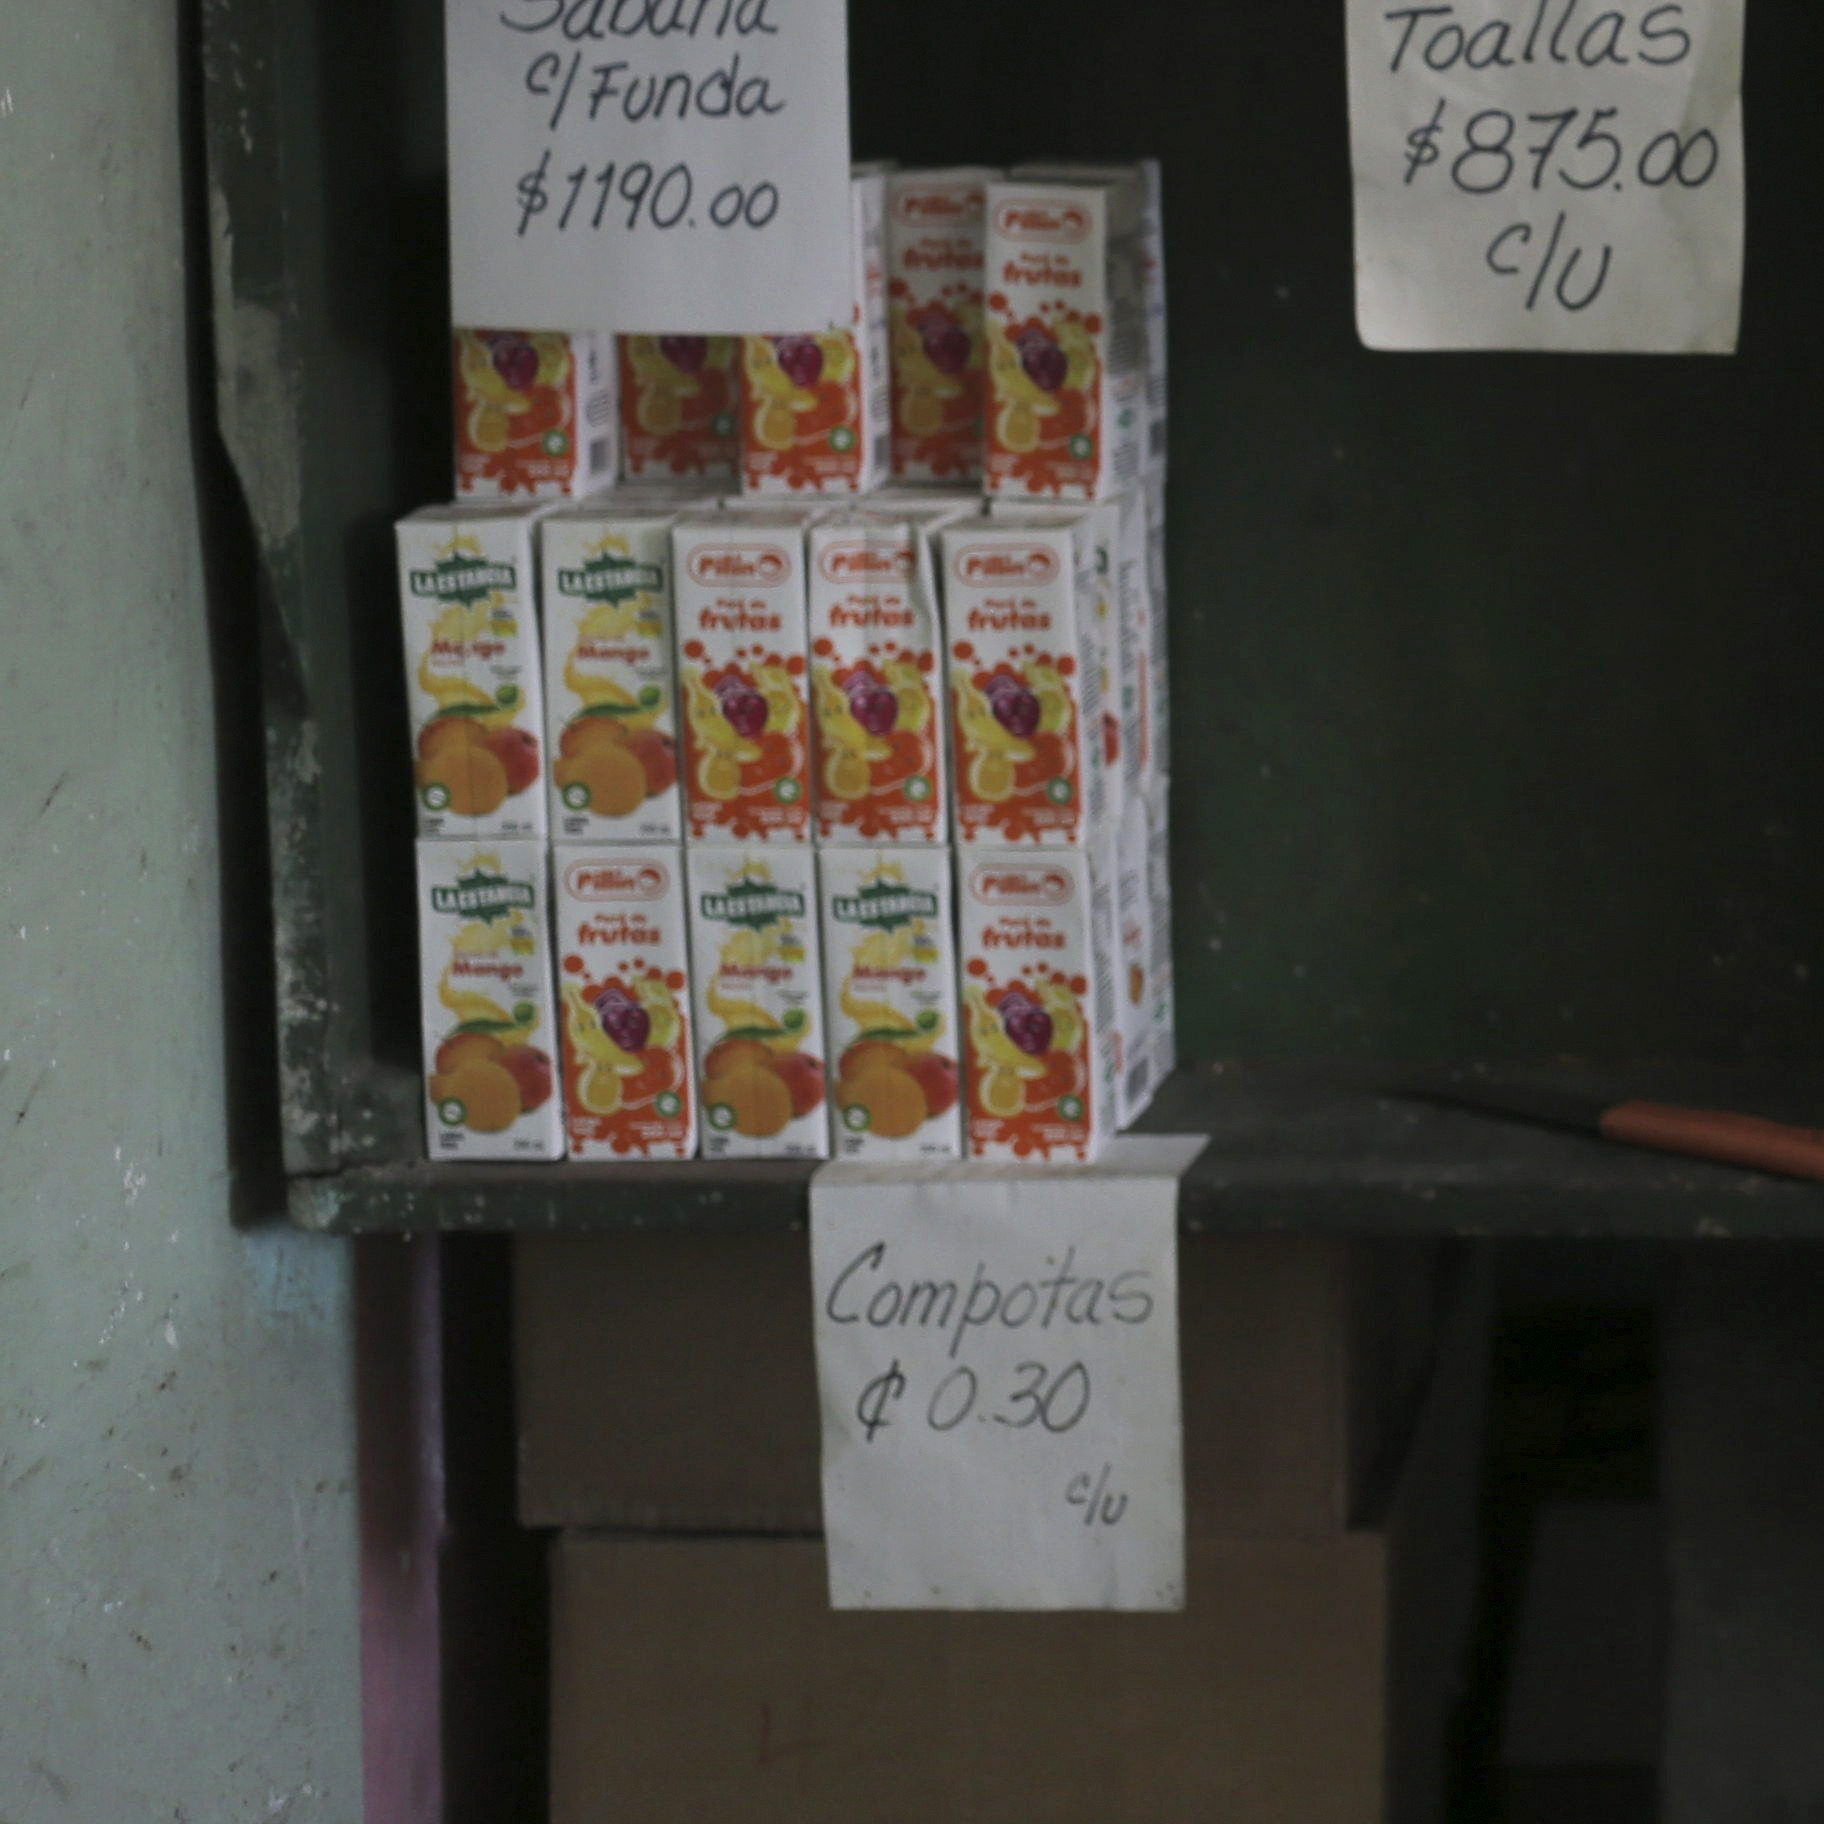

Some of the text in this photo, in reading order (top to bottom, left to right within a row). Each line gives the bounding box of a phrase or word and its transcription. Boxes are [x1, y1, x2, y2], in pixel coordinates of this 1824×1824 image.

[1404, 98, 1719, 194] $875.00
[517, 150, 779, 237] $1190.00
[699, 607, 783, 633] frutas
[829, 603, 915, 628] frutas
[968, 607, 1052, 631] frutas
[578, 924, 662, 947] frutas
[982, 926, 1067, 950] frutas
[826, 1241, 1154, 1359] Compotas
